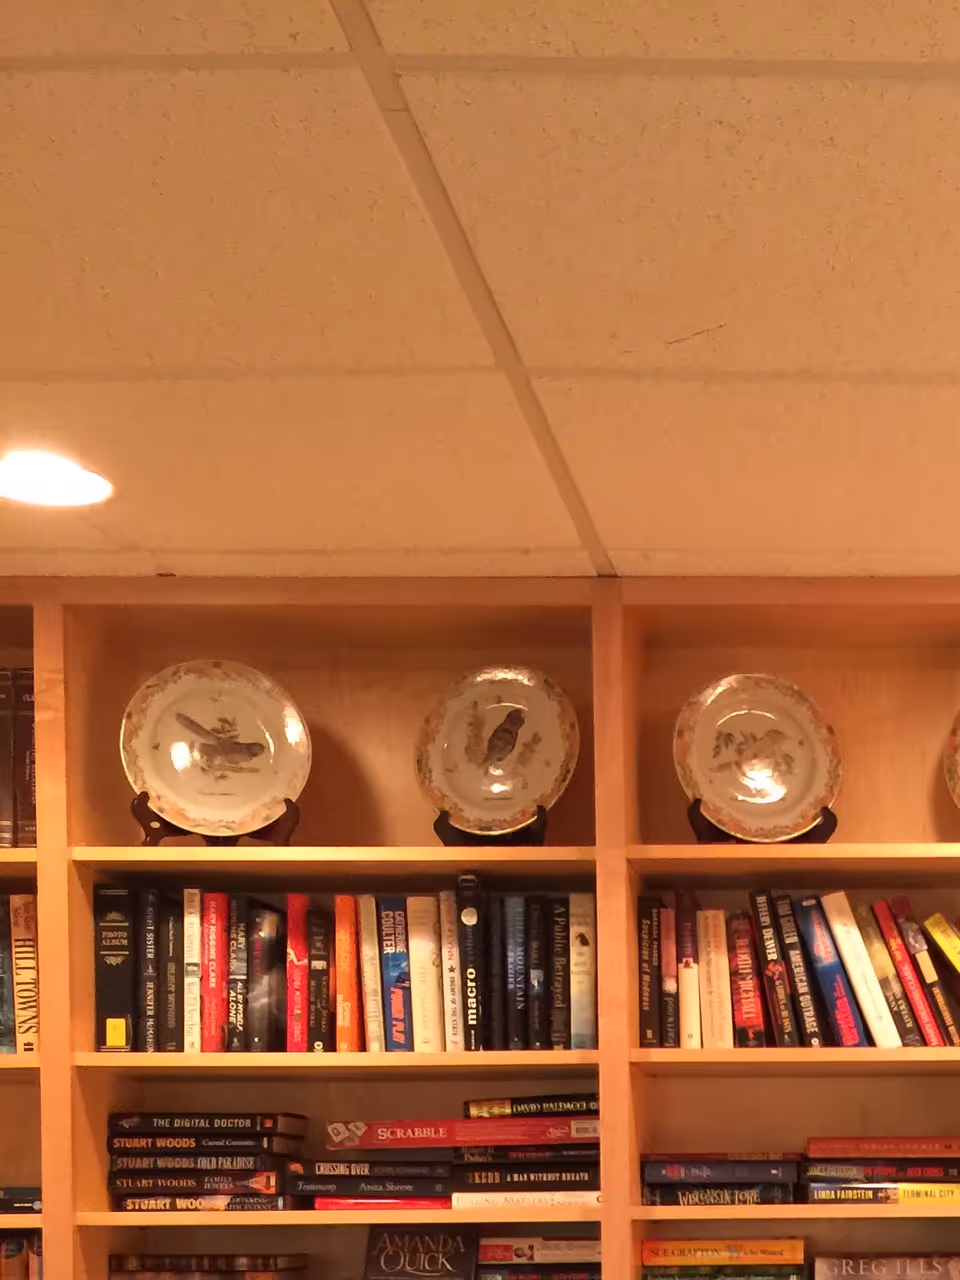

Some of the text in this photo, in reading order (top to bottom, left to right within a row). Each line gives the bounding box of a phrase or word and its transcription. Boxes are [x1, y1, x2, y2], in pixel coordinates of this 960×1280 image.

[381, 911, 395, 954] COULTER
[395, 911, 406, 953] CATHERINE
[756, 896, 778, 960] JEFFERY DEAVER
[551, 905, 566, 1008] A Public Betrayed
[642, 919, 651, 1011] Suspicion of Madness
[777, 899, 792, 915] TIM
[789, 949, 808, 993] AMERICAN
[799, 995, 818, 1034] OUTRAGE
[14, 938, 38, 1034] HILL TOWNS
[466, 968, 477, 1025] macro
[513, 1101, 587, 1114] DAVID BALDACCI
[153, 1118, 252, 1128] THE DIGITAL DOCTOR
[377, 1127, 448, 1139] SCRABBLE
[116, 1156, 156, 1169] STUART
[157, 1156, 195, 1169] WOODS
[218, 1157, 256, 1169] PARADISE
[315, 1163, 370, 1176] CROSSING OVER
[116, 1179, 197, 1188] STUART WOODS
[678, 1189, 760, 1206] WISCONSIN LORE
[815, 1189, 955, 1200] LINDA FAIRSTEIN TERMINAL CITY
[374, 1233, 464, 1255] AMANDA
[651, 1248, 722, 1257] SUE GRAFTON
[380, 1248, 457, 1276] QUICK
[826, 1258, 943, 1275] GREG ILES
